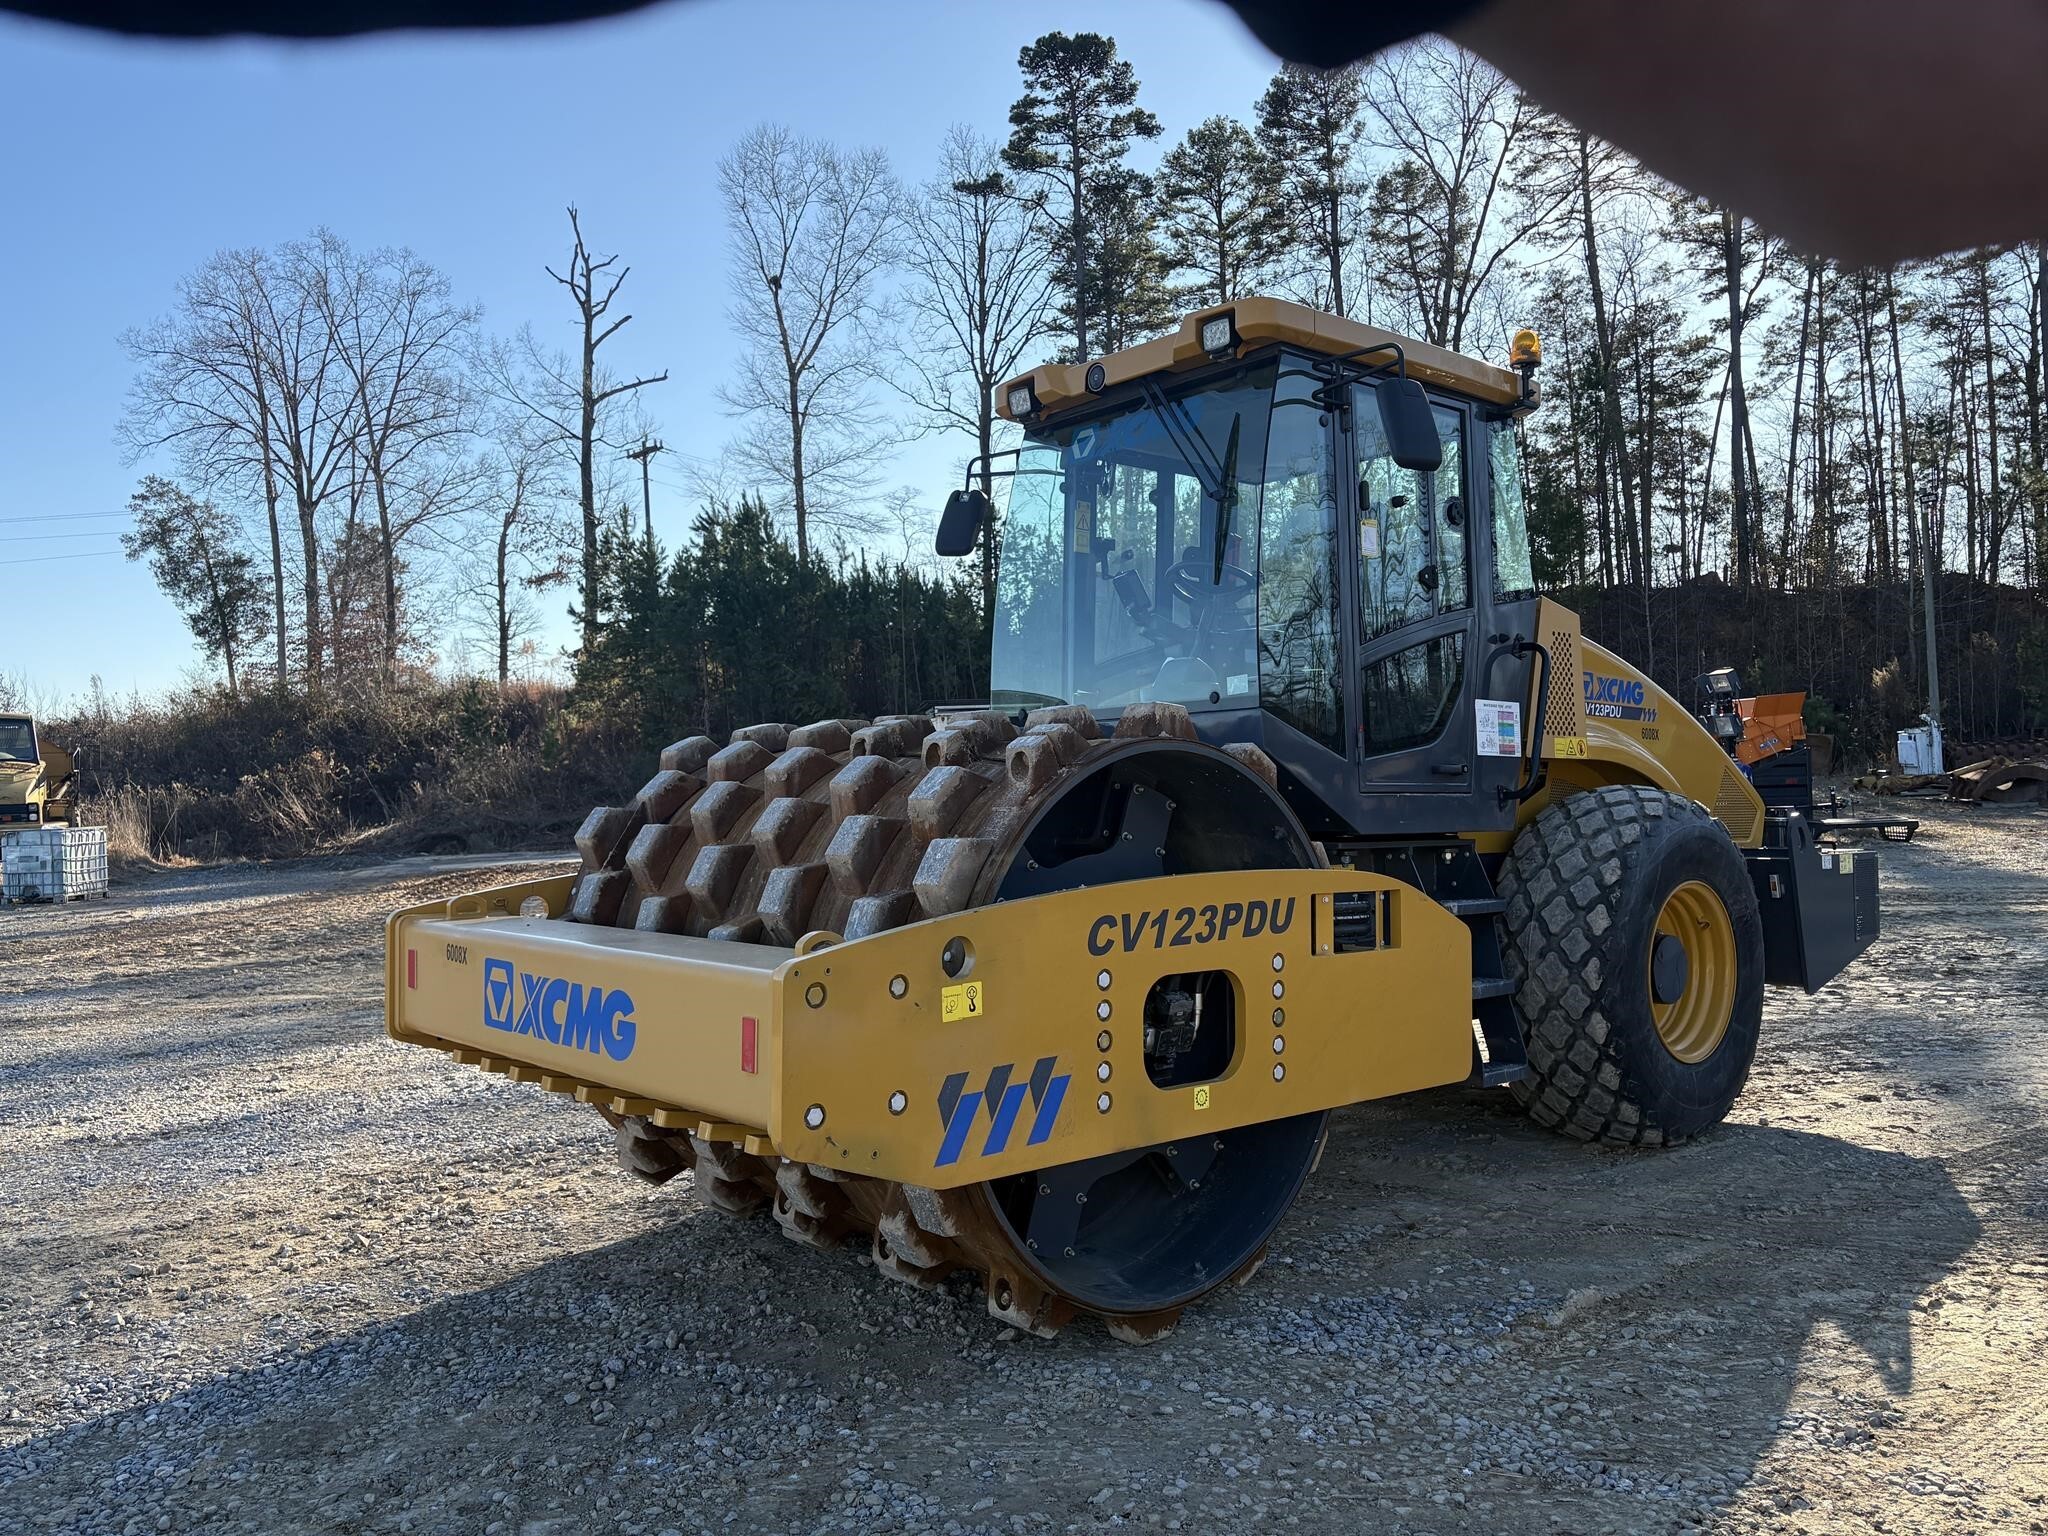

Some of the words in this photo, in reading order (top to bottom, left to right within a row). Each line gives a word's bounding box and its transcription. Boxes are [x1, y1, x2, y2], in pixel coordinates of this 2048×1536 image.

[1594, 678, 1644, 705] XCMG
[1585, 702, 1622, 718] V123PDU
[1087, 897, 1297, 957] CV123PDU
[446, 944, 467, 965] 6008X
[514, 972, 636, 1061] XCMG
